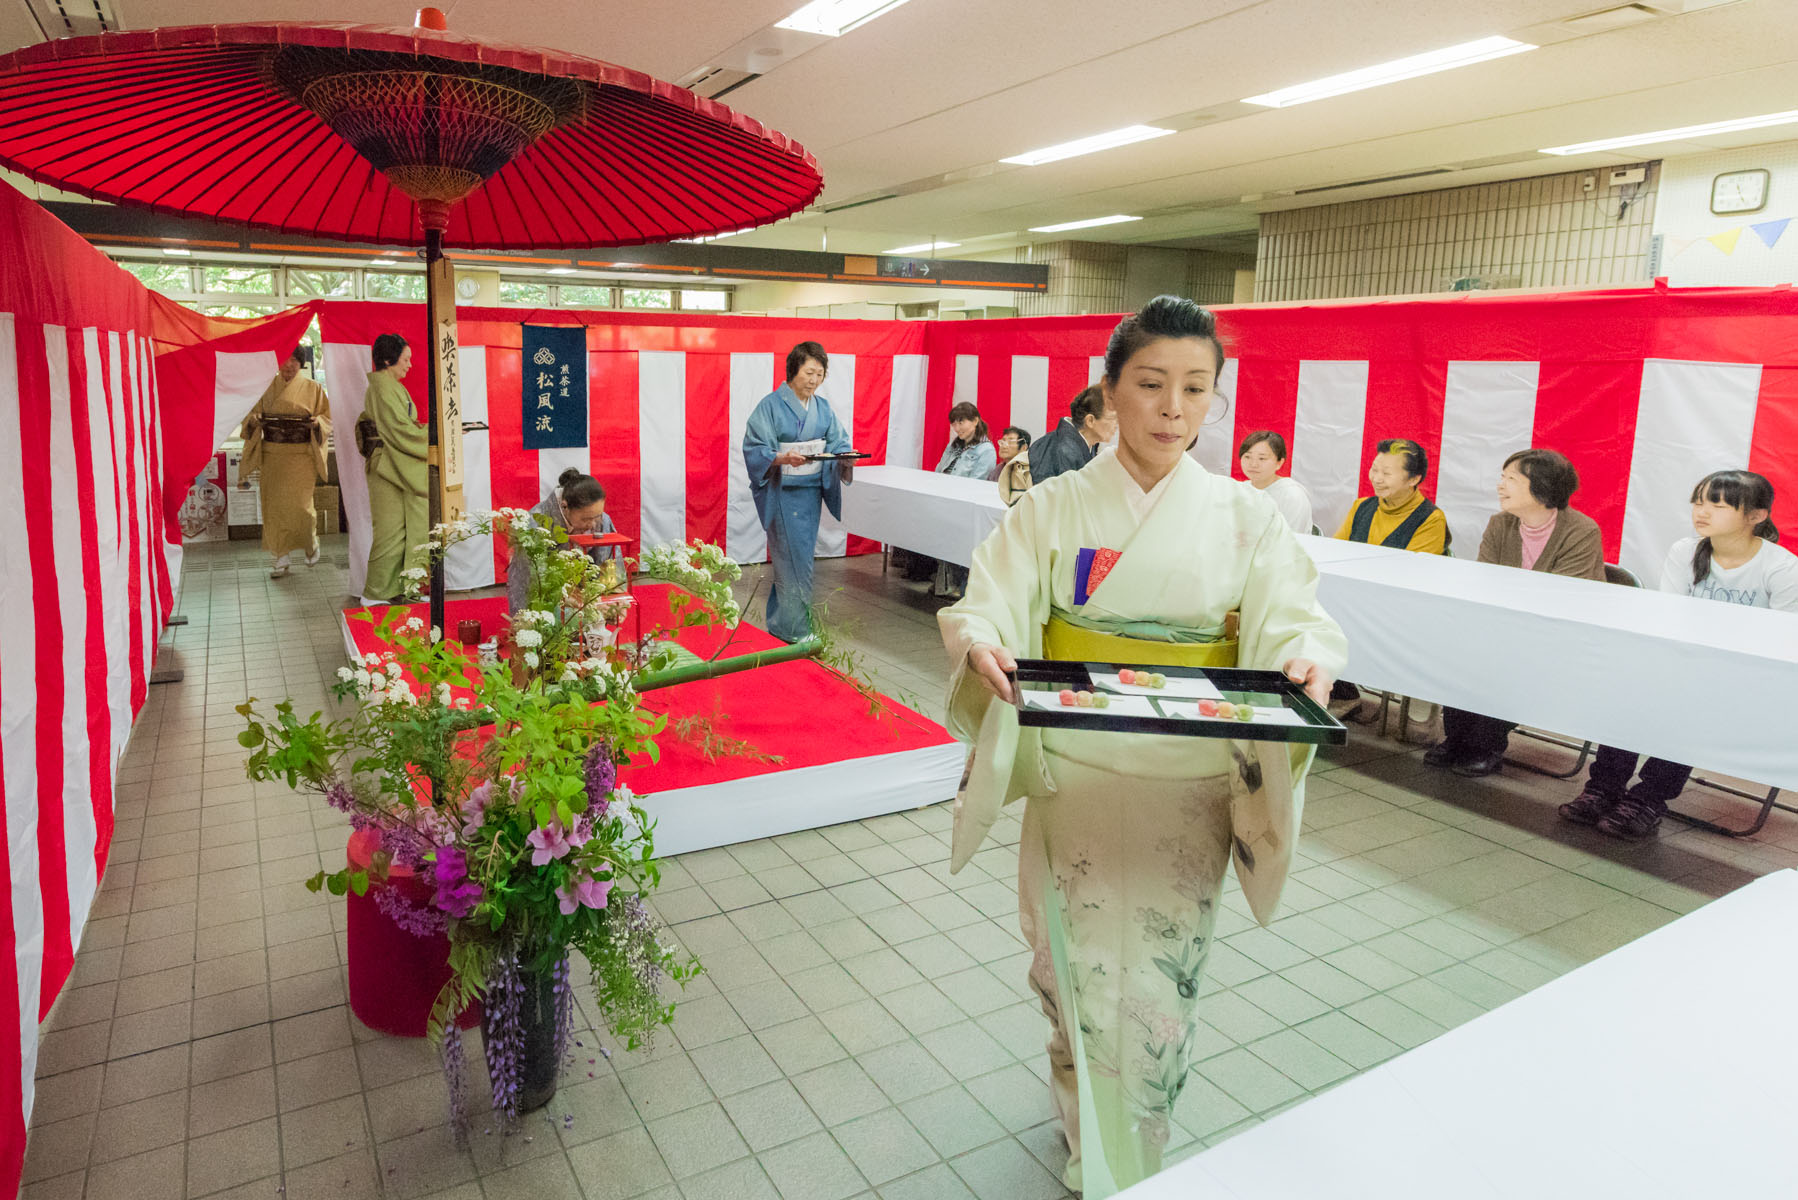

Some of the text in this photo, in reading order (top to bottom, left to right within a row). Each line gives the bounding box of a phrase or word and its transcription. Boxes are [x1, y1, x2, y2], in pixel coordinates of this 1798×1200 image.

[535, 371, 554, 432] 松風流
[559, 363, 571, 397] 煎茶道
